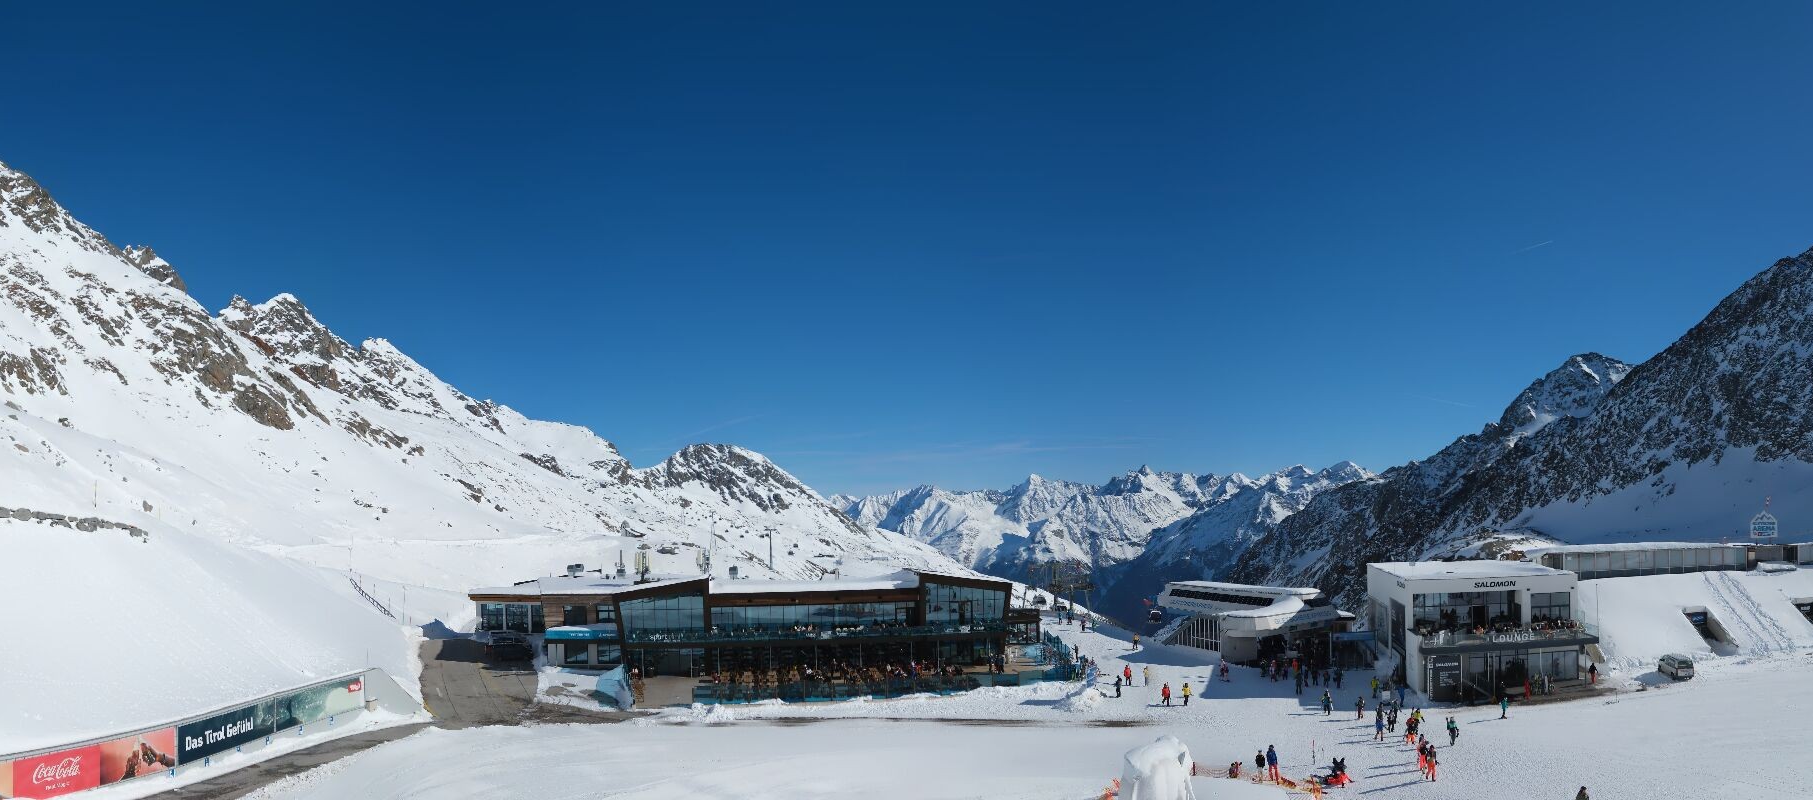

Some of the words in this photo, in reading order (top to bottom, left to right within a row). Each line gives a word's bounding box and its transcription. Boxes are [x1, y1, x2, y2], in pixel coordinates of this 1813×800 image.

[1474, 580, 1516, 588] SALOMON
[1492, 633, 1535, 642] LOUNGE
[185, 736, 204, 751] Das
[204, 726, 226, 745] Tirol
[226, 716, 254, 738] Gefühl
